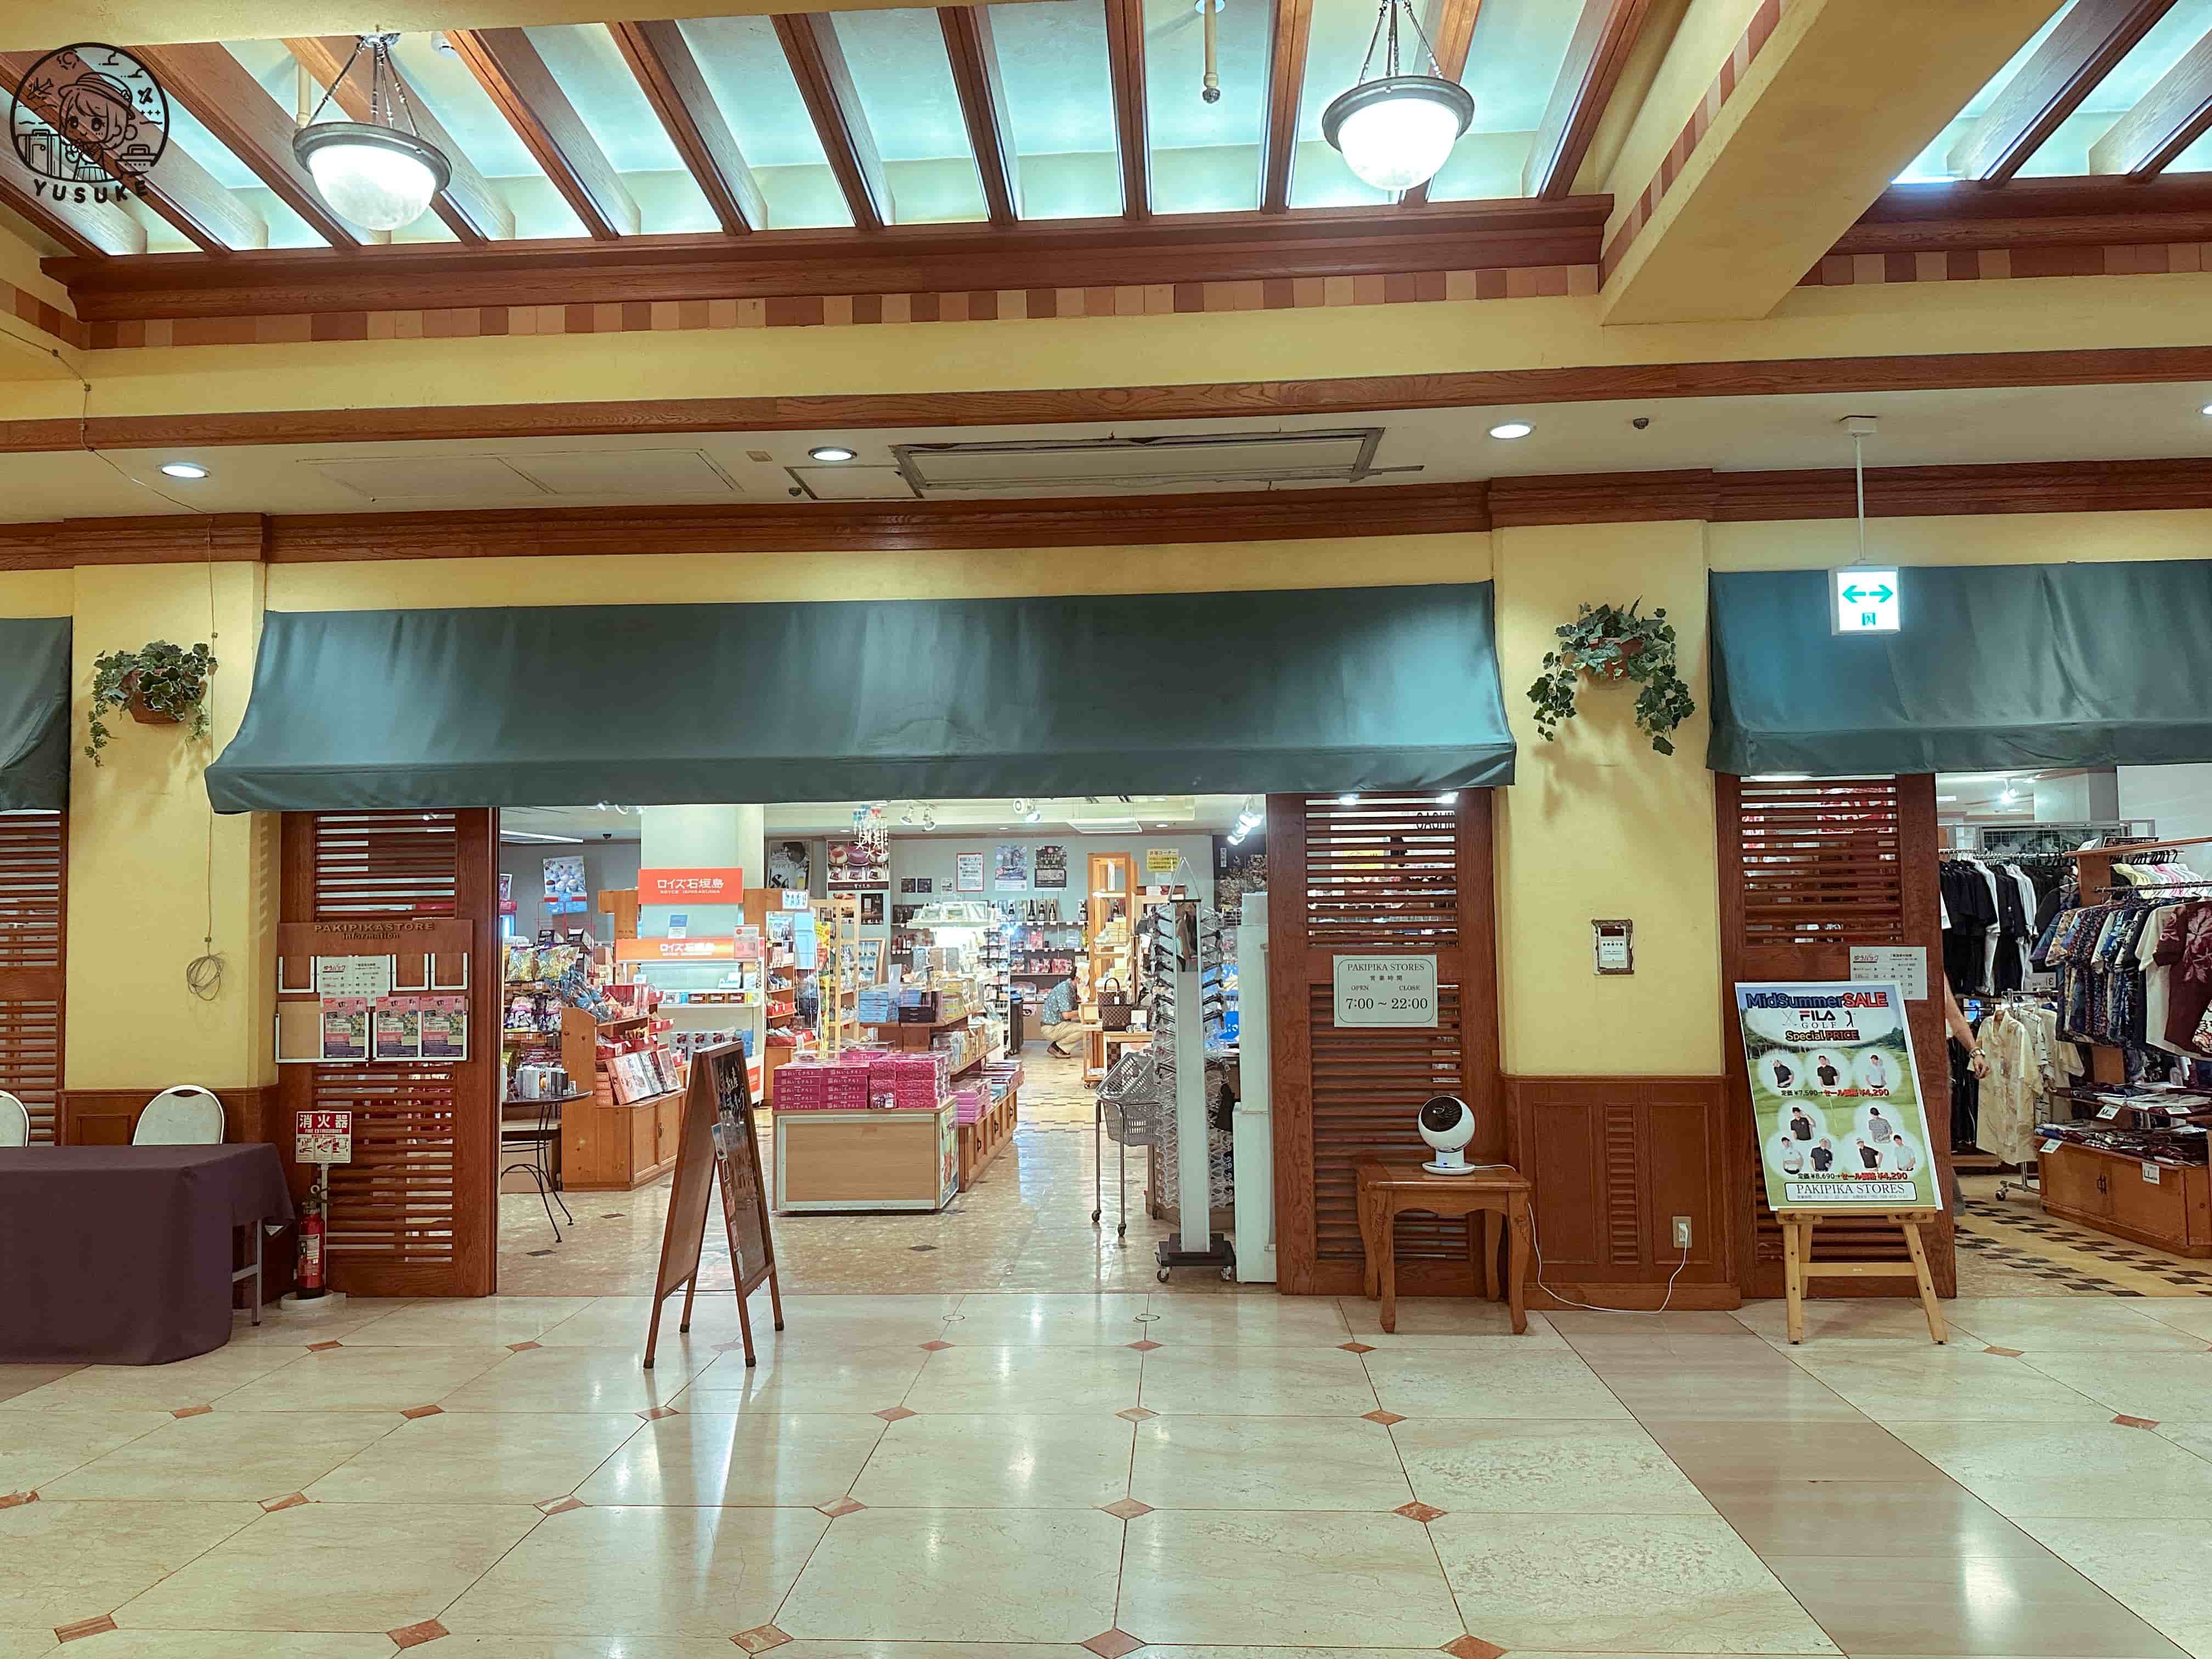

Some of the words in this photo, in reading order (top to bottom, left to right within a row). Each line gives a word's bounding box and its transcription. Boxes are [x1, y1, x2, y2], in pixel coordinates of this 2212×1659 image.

[657, 878, 724, 889] ロイズ石垣島
[1346, 998, 1374, 1009] 7:00
[1391, 998, 1428, 1009] 22:00
[1799, 1010, 1836, 1021] FILA
[1786, 1030, 1825, 1041] Special
[1826, 1030, 1860, 1040] PRICE
[300, 1114, 348, 1128] 消火器
[1796, 1184, 1853, 1194] PAKIPIKA
[1857, 1184, 1905, 1194] STORES
